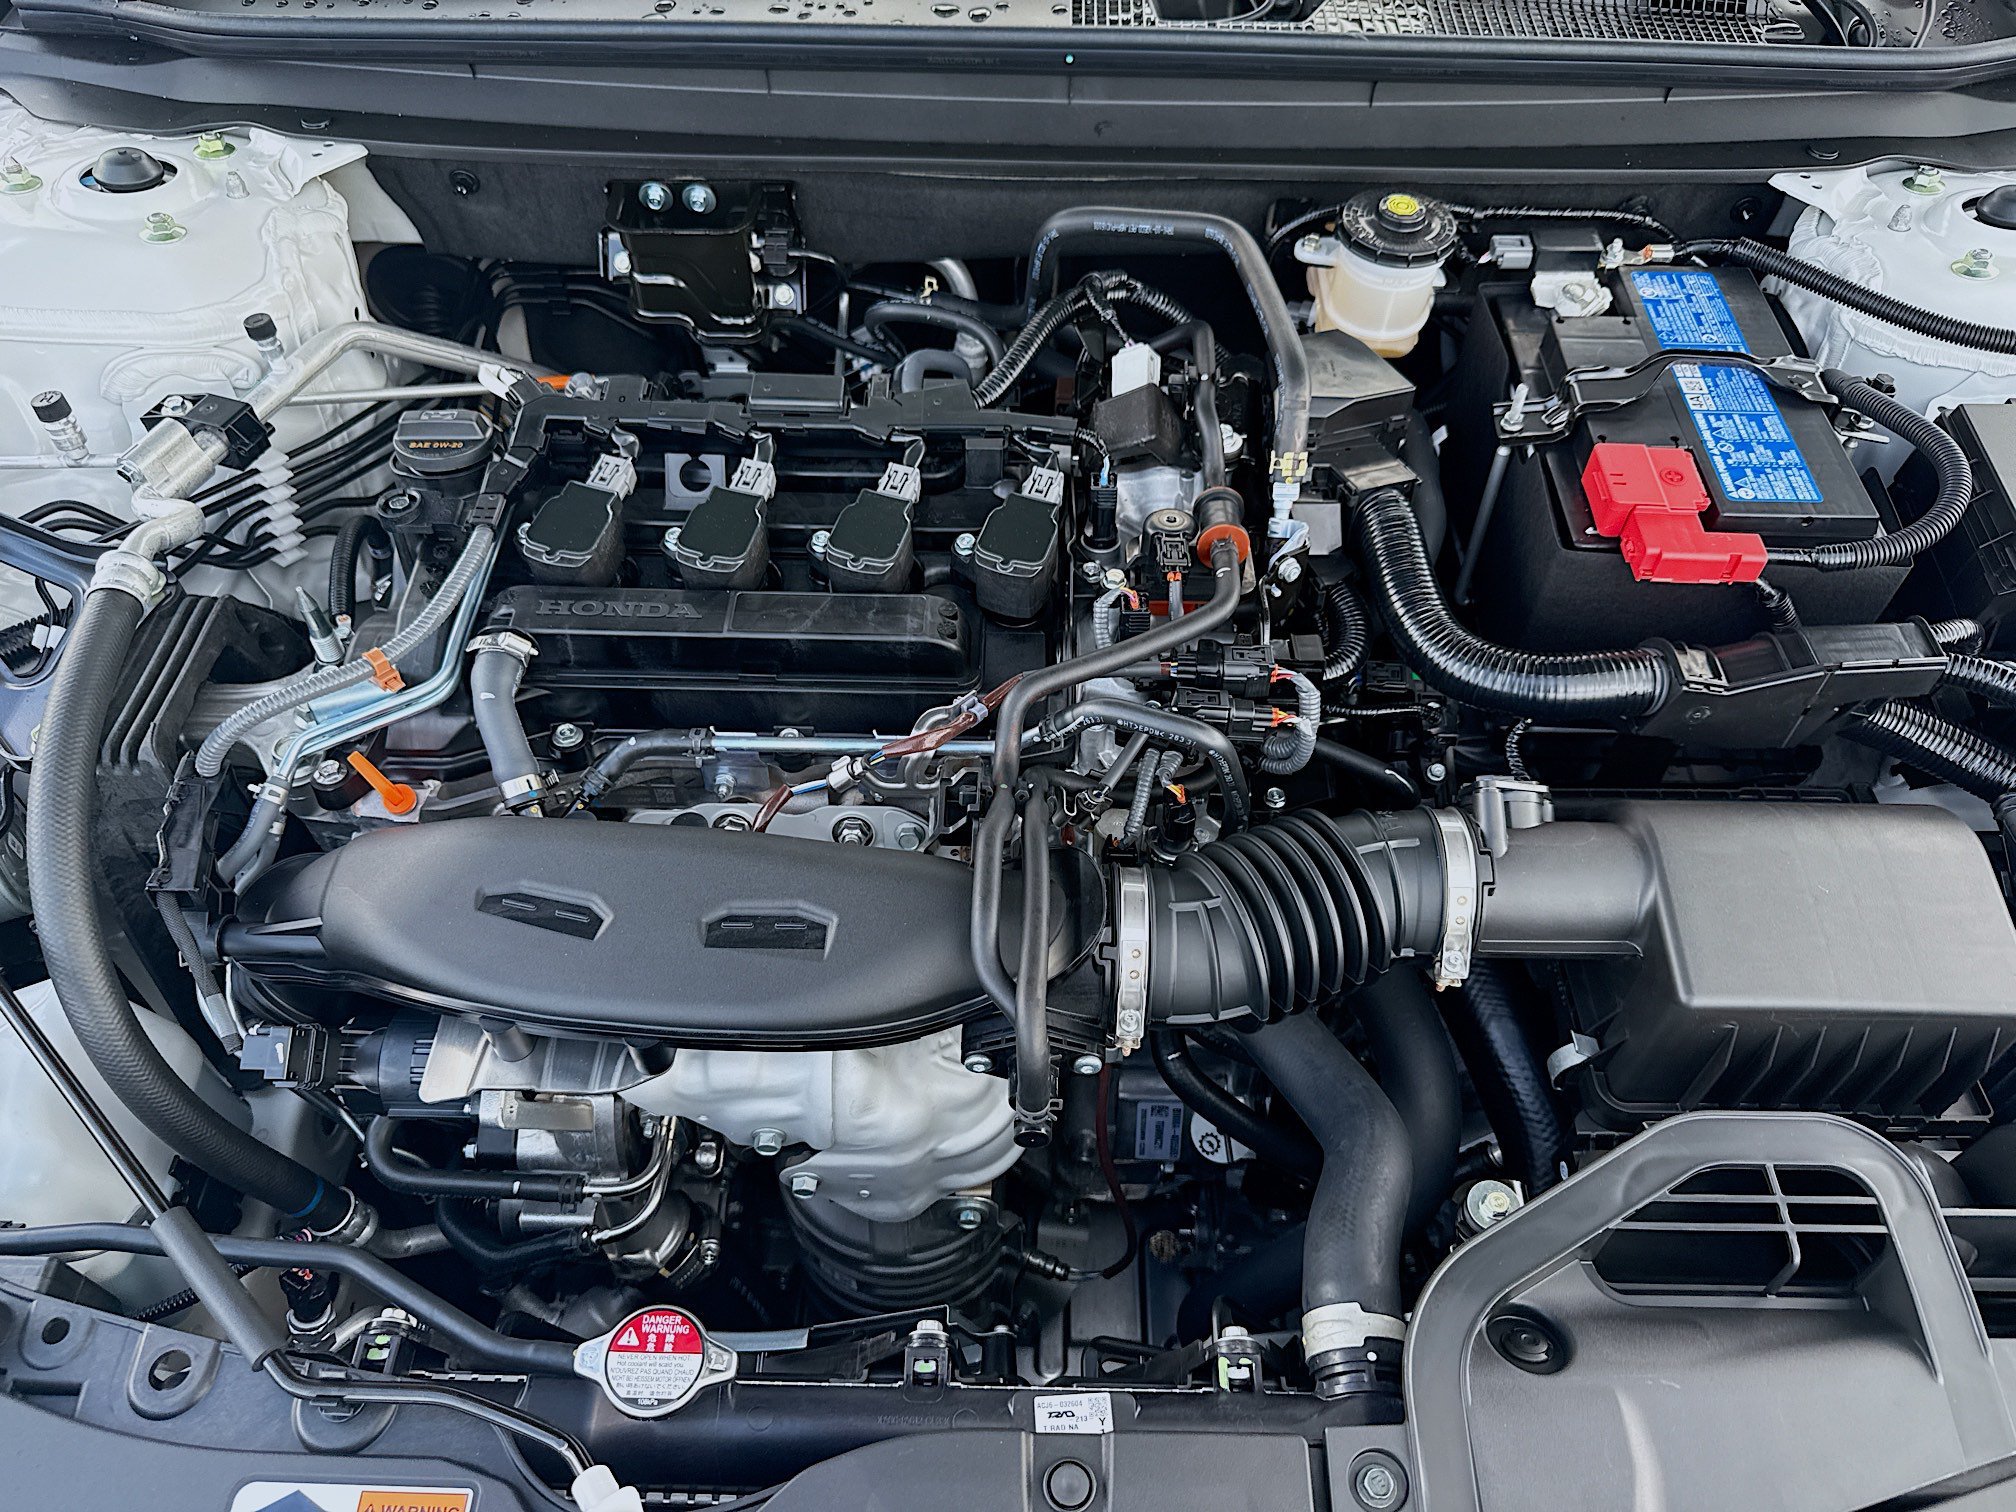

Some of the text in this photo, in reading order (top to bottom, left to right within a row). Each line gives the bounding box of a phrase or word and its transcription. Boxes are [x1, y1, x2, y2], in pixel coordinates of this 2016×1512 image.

[408, 441, 464, 449] SAE 0W-20
[536, 599, 703, 619] HONDA
[642, 1314, 682, 1324] DANGER
[641, 1324, 689, 1334] WARNUNG
[1099, 1417, 1105, 1425] Y
